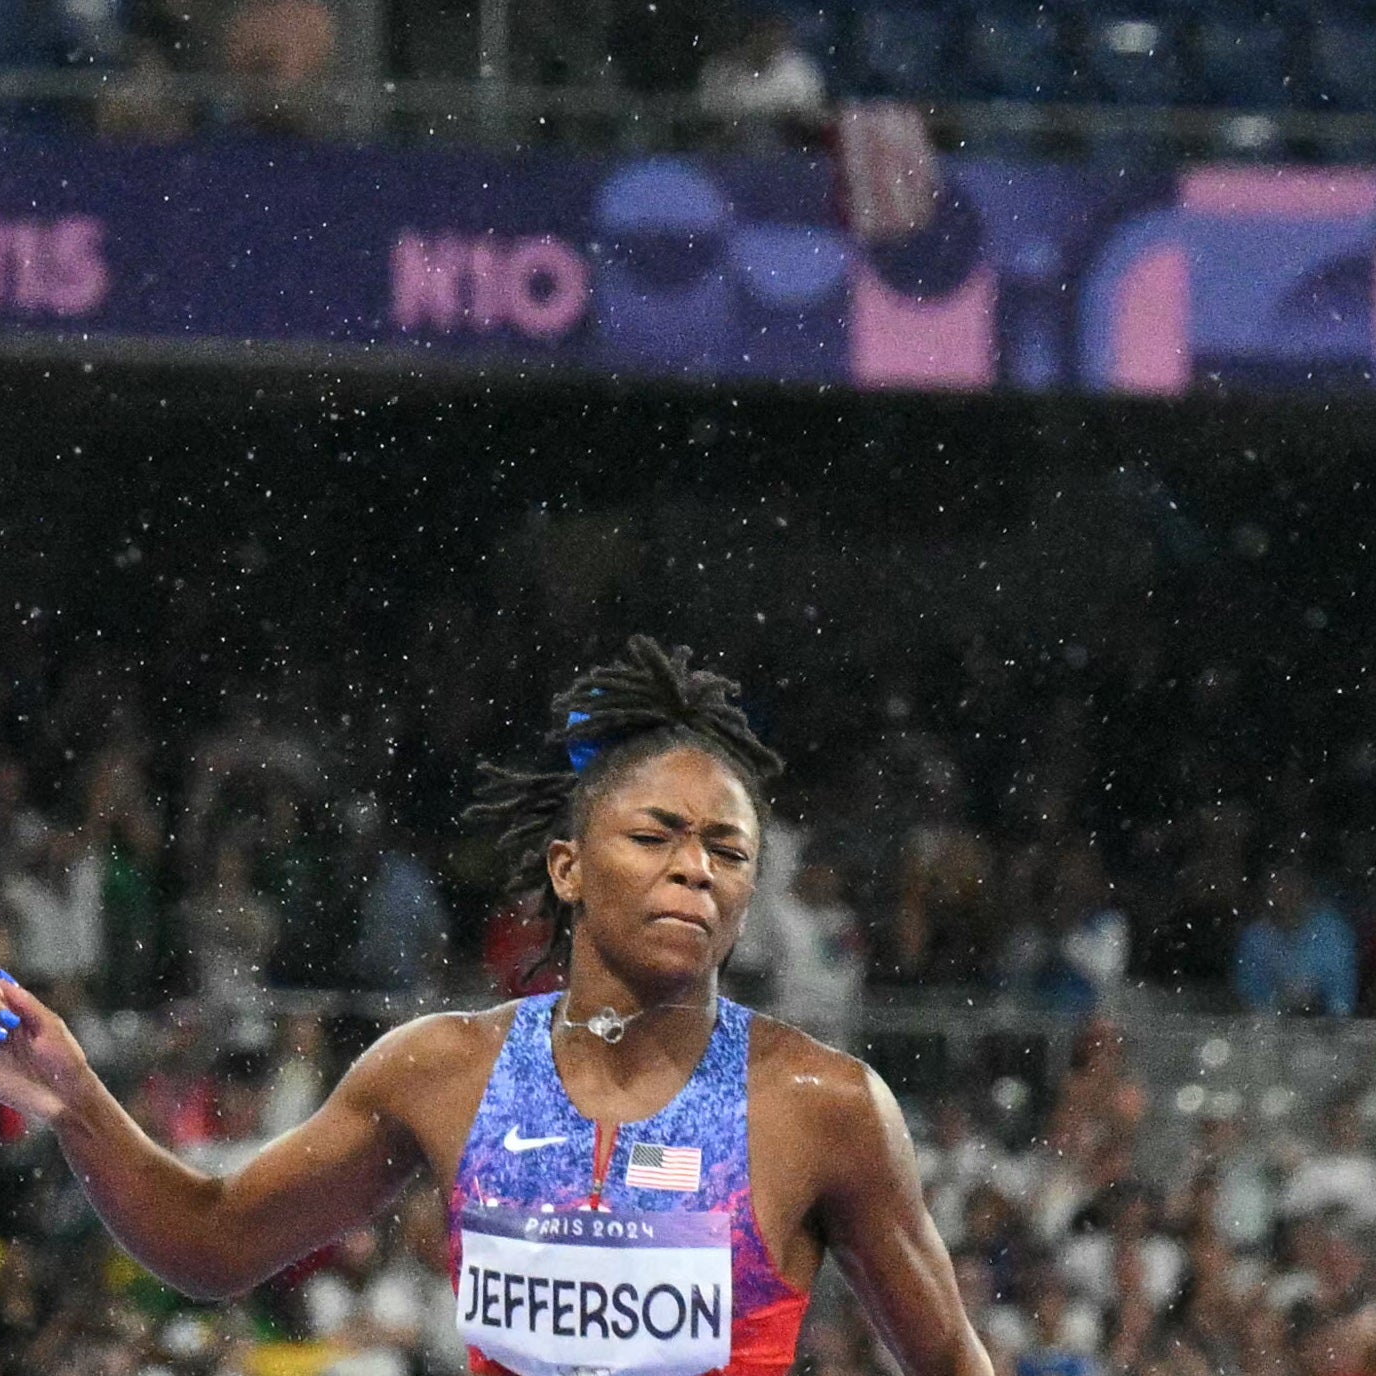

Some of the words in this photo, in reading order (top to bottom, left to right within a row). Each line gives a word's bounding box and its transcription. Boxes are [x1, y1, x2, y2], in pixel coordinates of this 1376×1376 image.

[524, 1216, 584, 1237] PARIS
[592, 1219, 655, 1240] 2024
[464, 1264, 722, 1341] JEFFERSON
